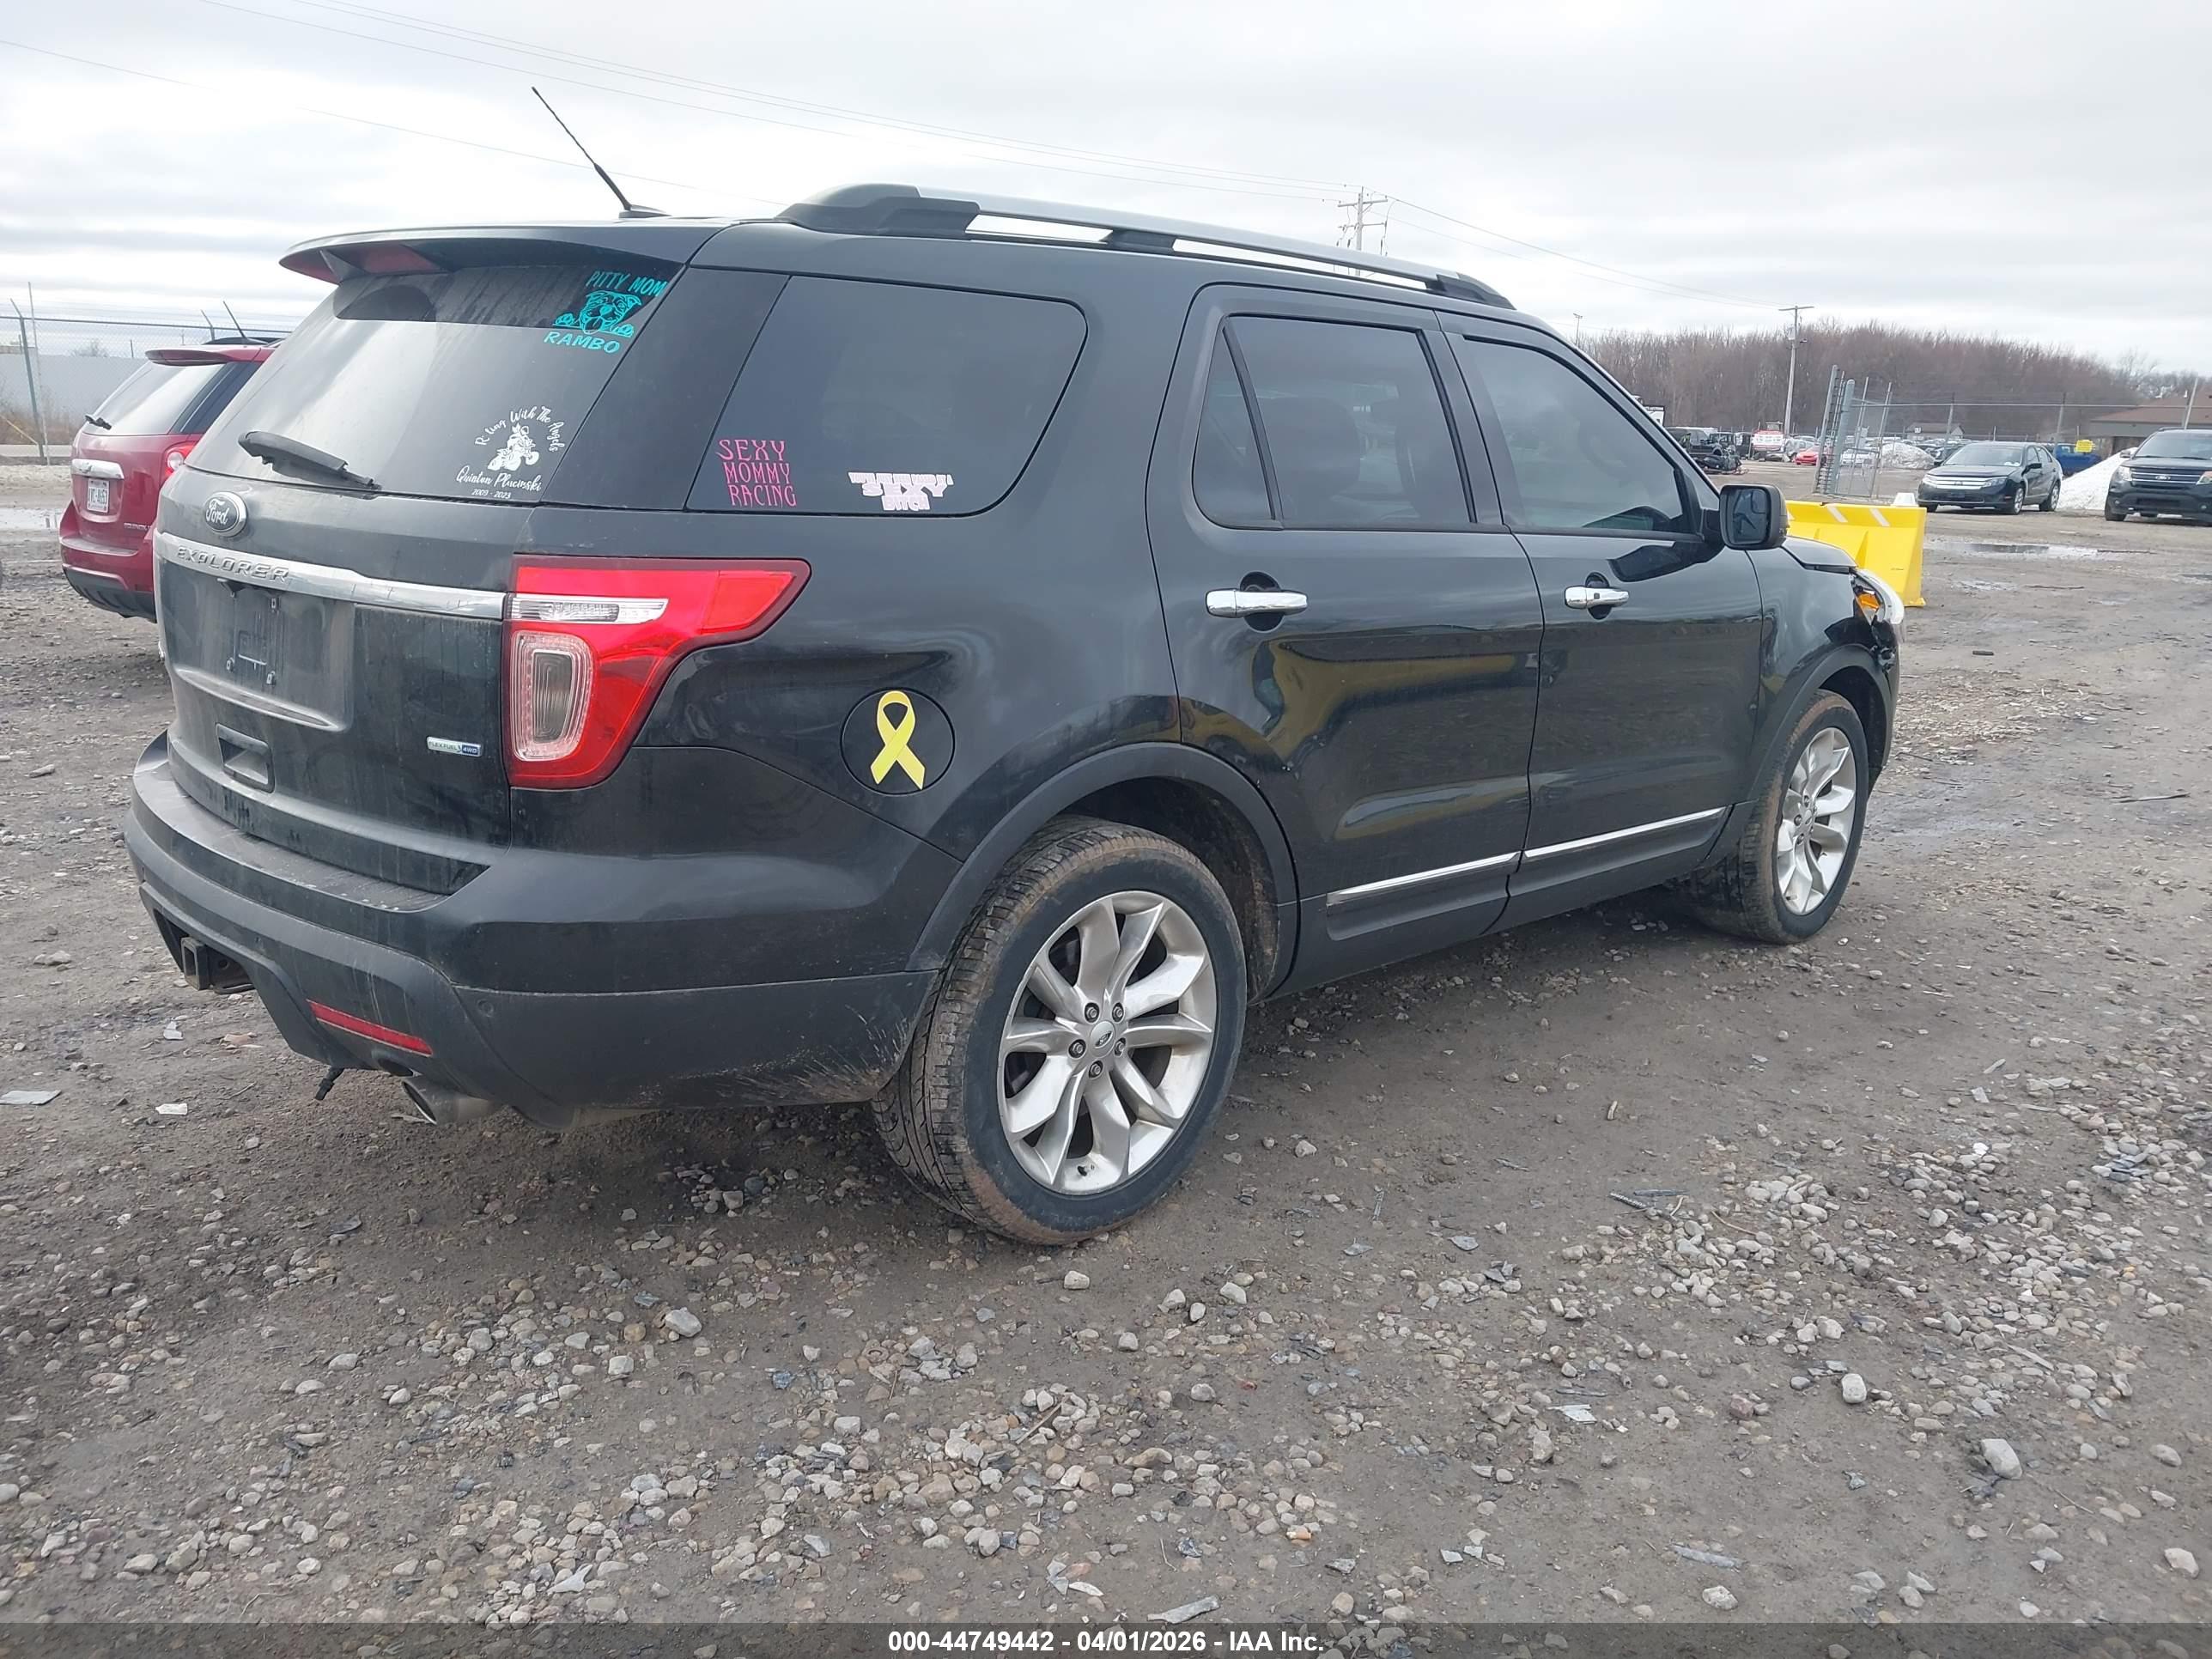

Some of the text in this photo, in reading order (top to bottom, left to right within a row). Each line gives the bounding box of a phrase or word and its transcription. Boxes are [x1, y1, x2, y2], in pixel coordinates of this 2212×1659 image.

[586, 270, 668, 297] PITTY MOM
[543, 331, 620, 353] RAMBO
[510, 405, 537, 422] With
[536, 405, 551, 422] The
[546, 422, 566, 453] Angels
[715, 438, 785, 461] SEXY
[456, 465, 542, 492] Quinton Plucinski
[723, 461, 790, 484] MOMMY
[494, 490, 512, 500] 2023
[727, 484, 798, 509] RACING
[861, 480, 947, 497] SEXY
[205, 498, 228, 526] Ford
[881, 495, 931, 511] BITCH
[177, 544, 289, 584] EXPLORER
